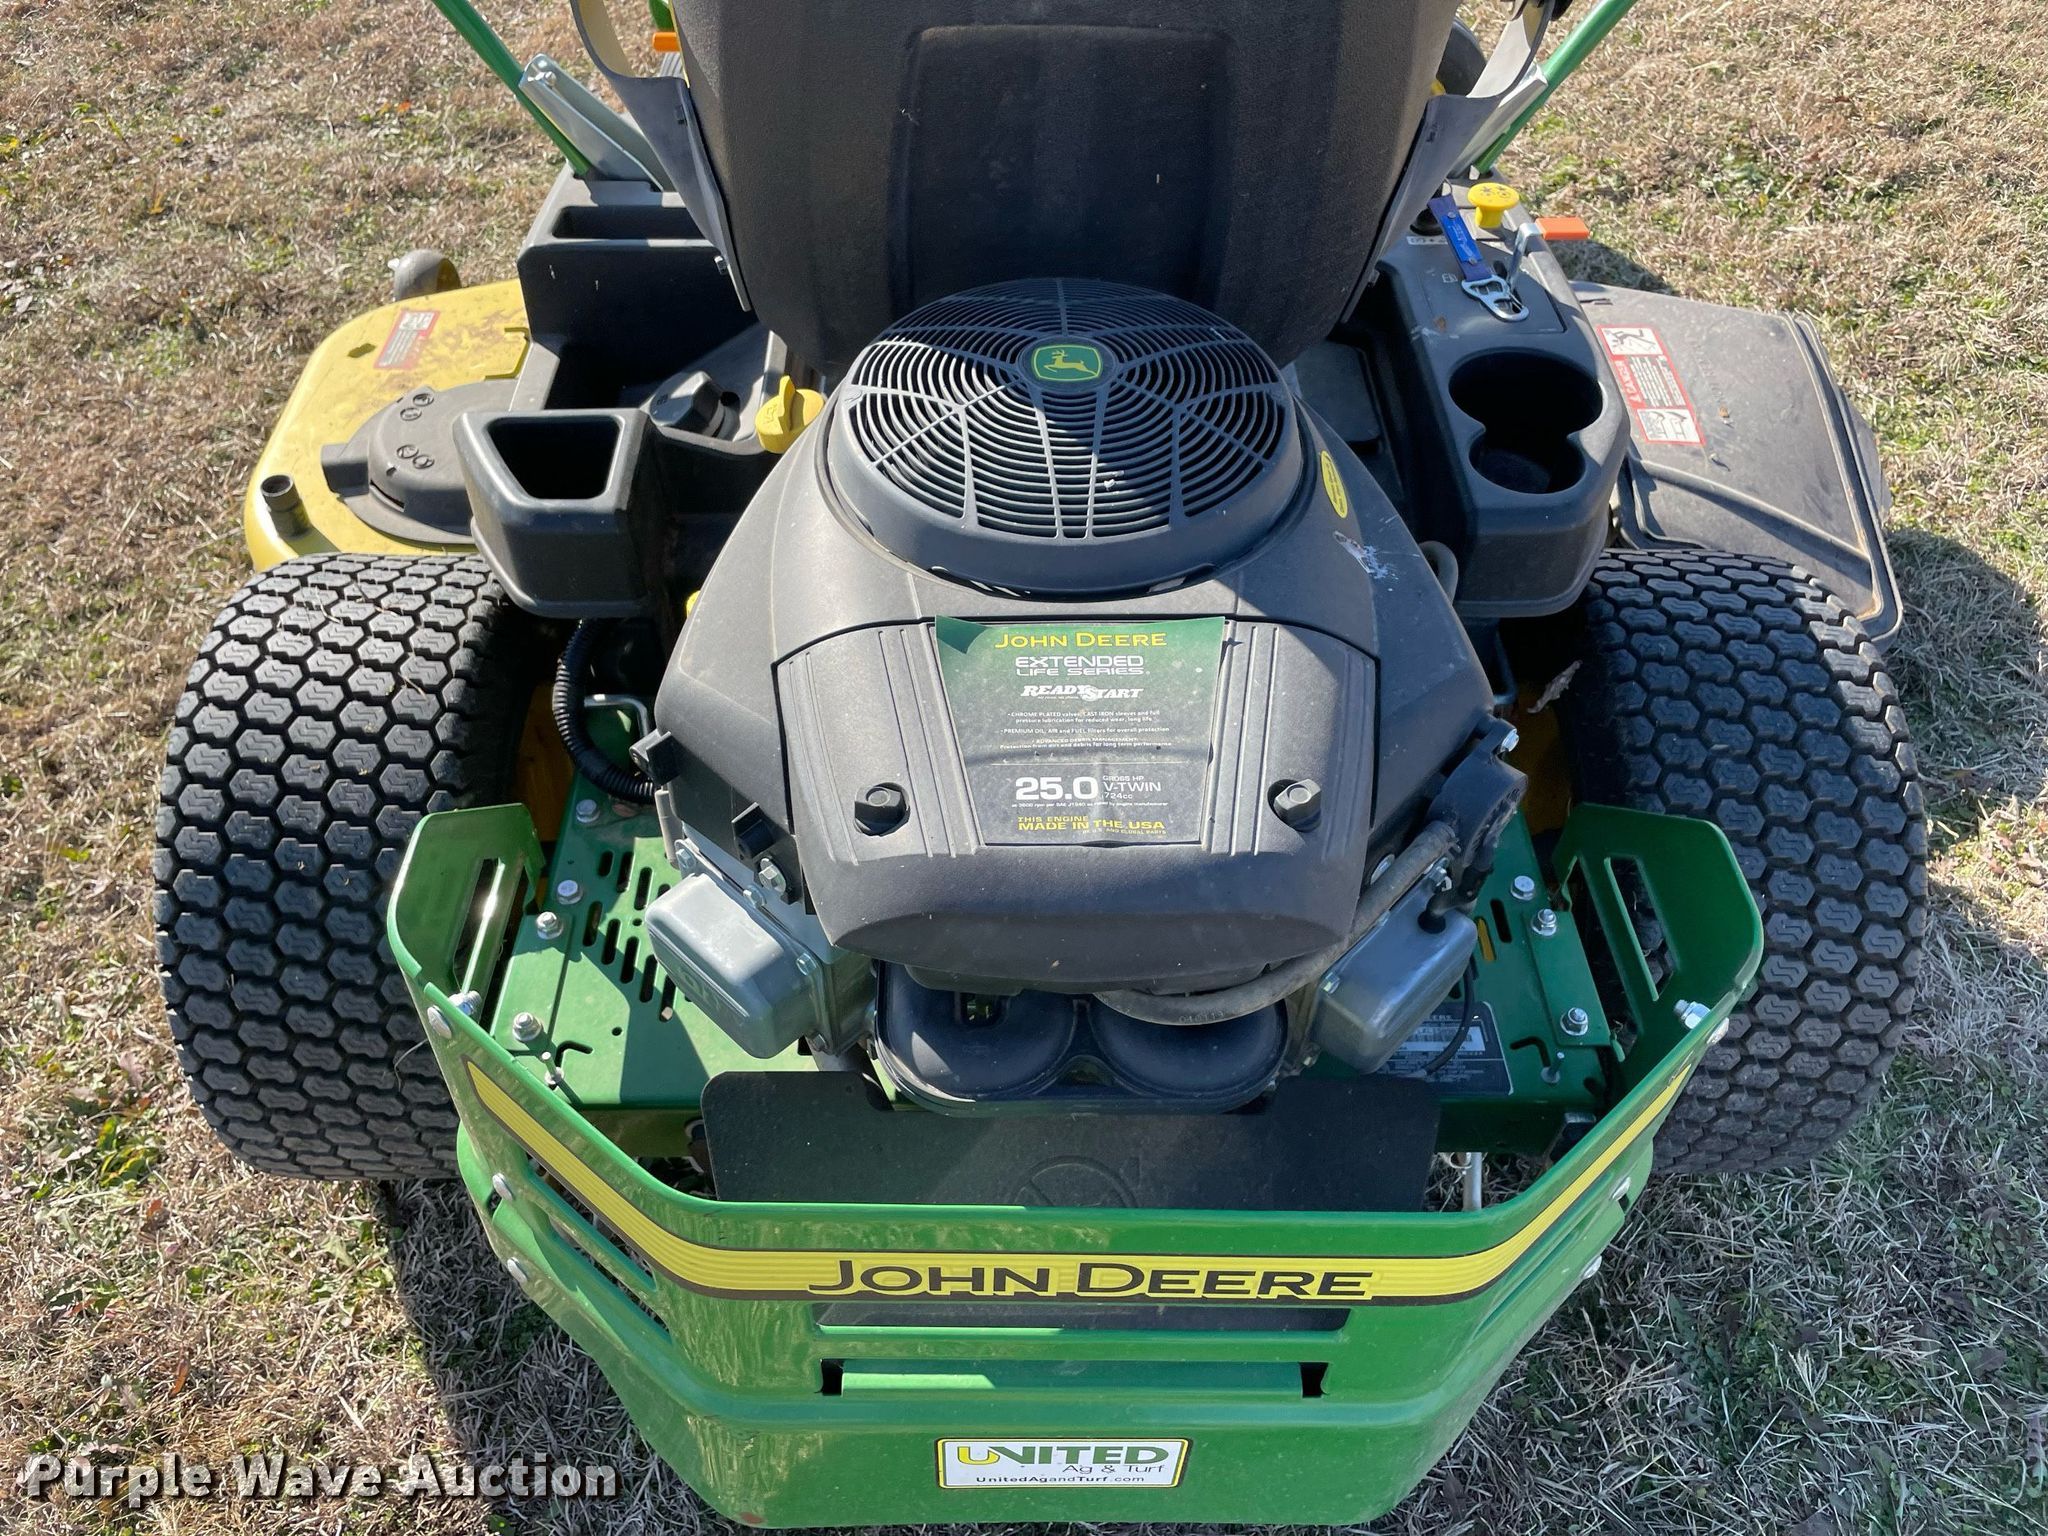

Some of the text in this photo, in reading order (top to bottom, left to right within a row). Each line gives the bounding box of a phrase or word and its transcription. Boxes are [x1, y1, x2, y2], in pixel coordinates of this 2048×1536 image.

[995, 632, 1167, 648] JOHN DEERE
[1015, 655, 1144, 668] EXTENDED
[1016, 668, 1059, 676] LIFE
[1015, 776, 1098, 800] 25.0
[1103, 781, 1161, 792] V-TWIN
[1018, 819, 1165, 831] MADE IN THE USA
[808, 1260, 1375, 1298] JOHN DEERE
[957, 1445, 1169, 1465] UNITED
[1062, 1464, 1166, 1474] Ag & Turf
[976, 1475, 1144, 1483] UnitedAgandTurf.com
